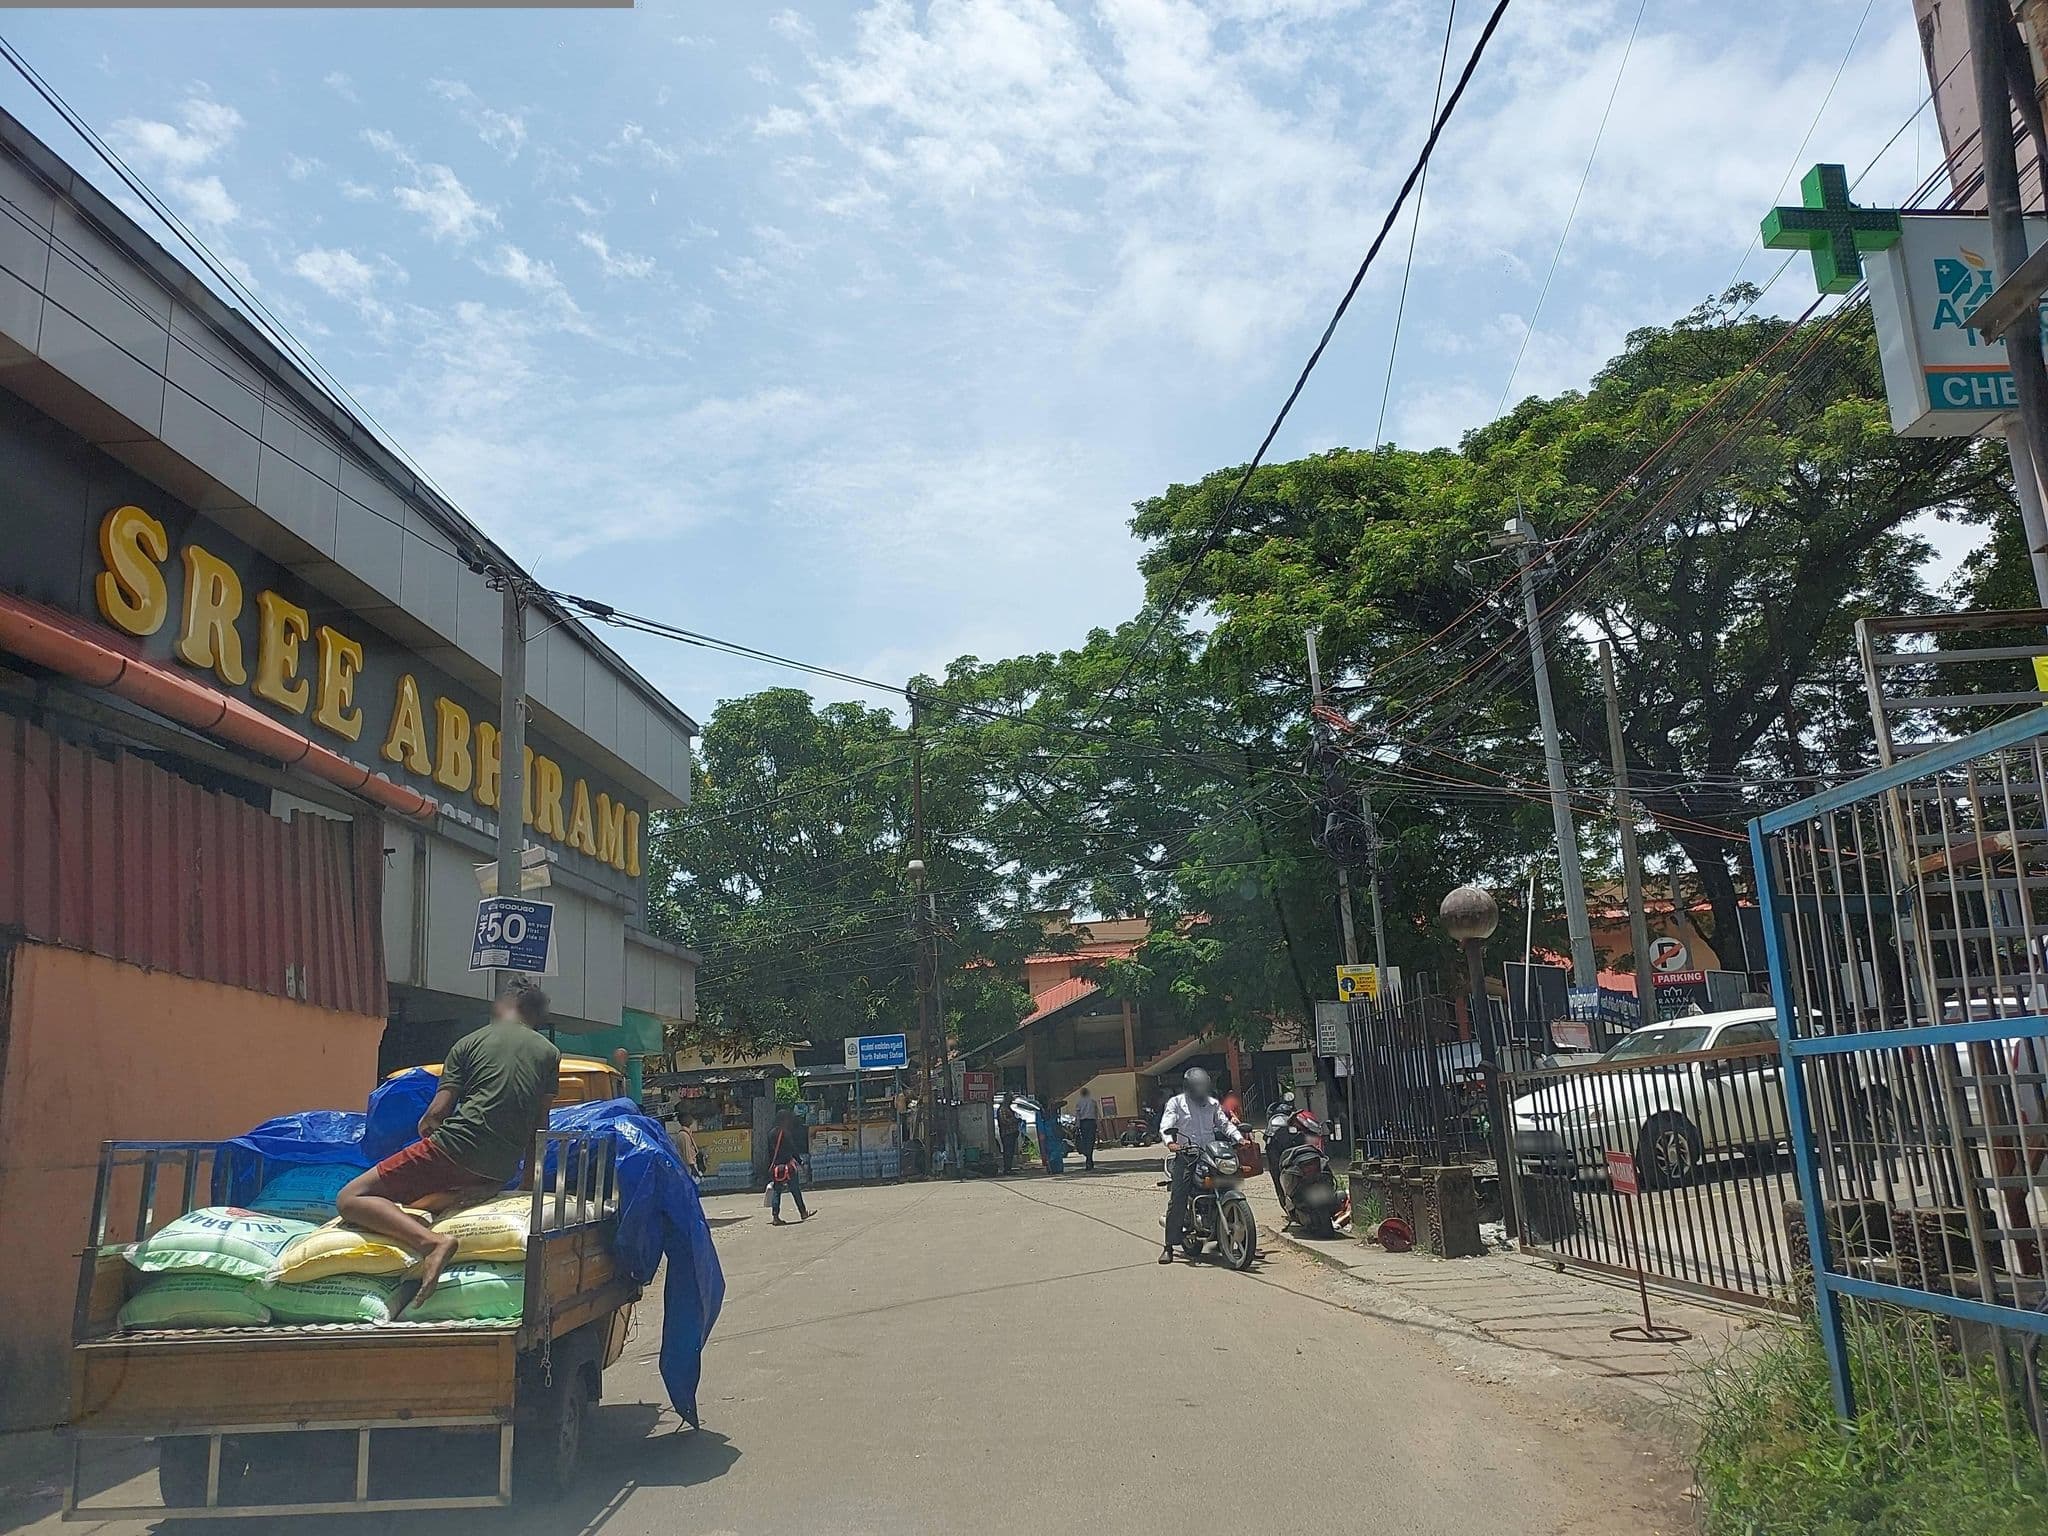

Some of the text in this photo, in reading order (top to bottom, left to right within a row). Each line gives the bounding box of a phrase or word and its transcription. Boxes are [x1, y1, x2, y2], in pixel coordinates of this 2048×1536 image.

[96, 505, 641, 877] SREE ABHIRAMI
[1657, 972, 1702, 984] PARKING
[1658, 996, 1689, 1005] RAYAN
[239, 1221, 288, 1234] BELL
